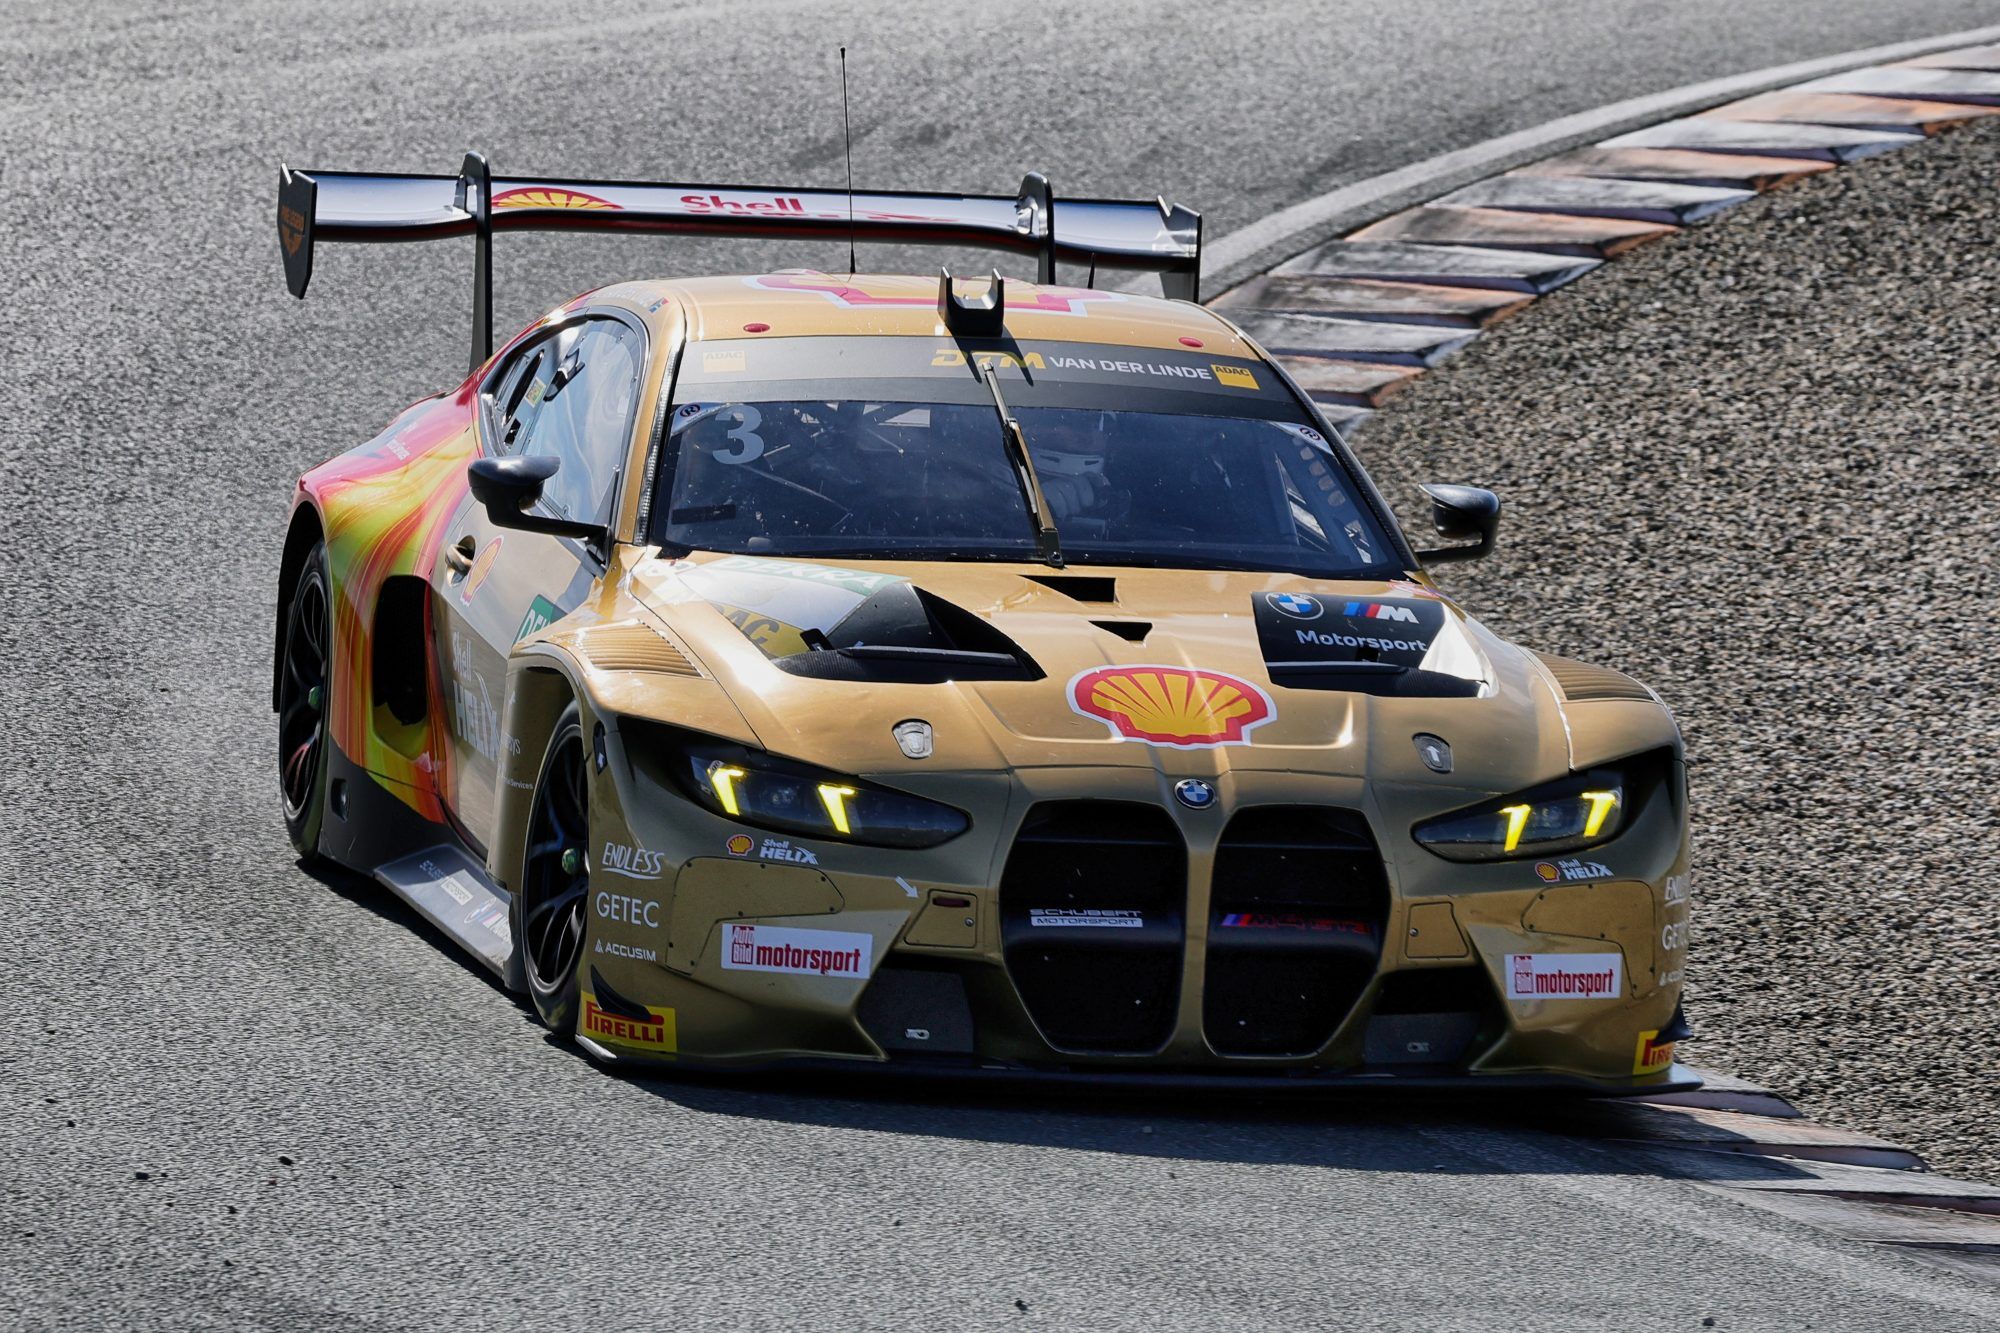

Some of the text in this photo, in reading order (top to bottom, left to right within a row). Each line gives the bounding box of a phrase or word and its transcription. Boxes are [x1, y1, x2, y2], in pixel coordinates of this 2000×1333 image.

[681, 195, 806, 215] Shell
[931, 349, 1046, 370] DTM
[1048, 356, 1213, 381] VAN DER LINDE
[1214, 365, 1250, 378] ADAC
[712, 404, 765, 465] 3
[1295, 629, 1428, 652] Motorsport
[453, 631, 472, 682] Shell
[762, 838, 790, 850] Shell
[601, 842, 665, 876] ENDLESS
[758, 845, 820, 866] HELIX
[1558, 858, 1582, 870] Shell
[1562, 861, 1615, 881] HELIX
[596, 891, 660, 929] GETEC
[1029, 908, 1143, 918] SCHUBERT
[1036, 917, 1138, 926] MOTORSPORT
[732, 926, 754, 946] Auto
[605, 941, 657, 962] ACCUSIM
[732, 944, 754, 964] Bild
[756, 944, 861, 975] motorsport
[1535, 969, 1615, 997] motorsport
[586, 1000, 664, 1044] PIRELLI
